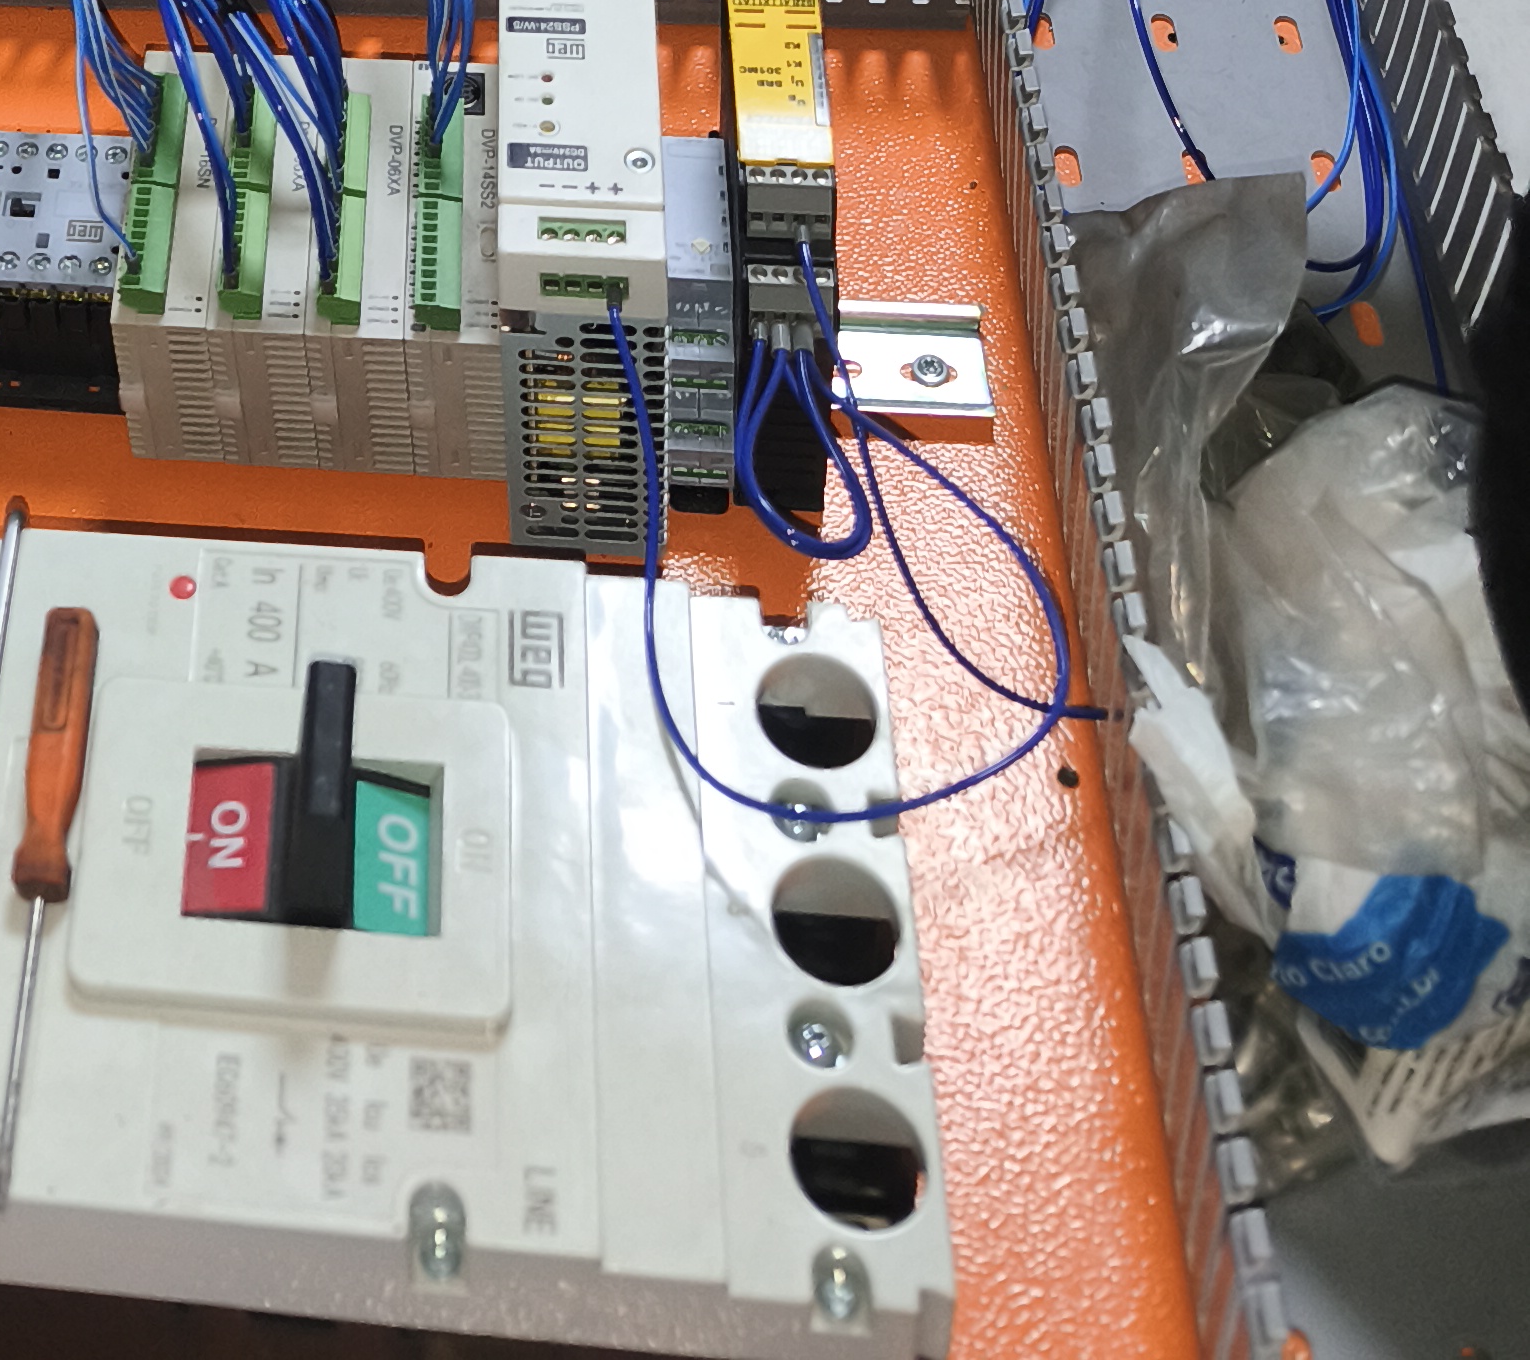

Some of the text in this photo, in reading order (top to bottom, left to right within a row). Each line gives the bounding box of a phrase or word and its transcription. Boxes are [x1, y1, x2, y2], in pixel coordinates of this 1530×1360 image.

[386, 124, 404, 196] DVP-06XA
[480, 128, 496, 210] DVP-14SS2
[524, 156, 585, 169] OUTPUT
[246, 601, 283, 643] 400
[245, 660, 280, 677] A
[120, 795, 154, 859] OFF
[208, 800, 248, 870] ON
[376, 813, 420, 920] OFF
[1308, 941, 1393, 982] Claro
[522, 1164, 558, 1236] LINE
